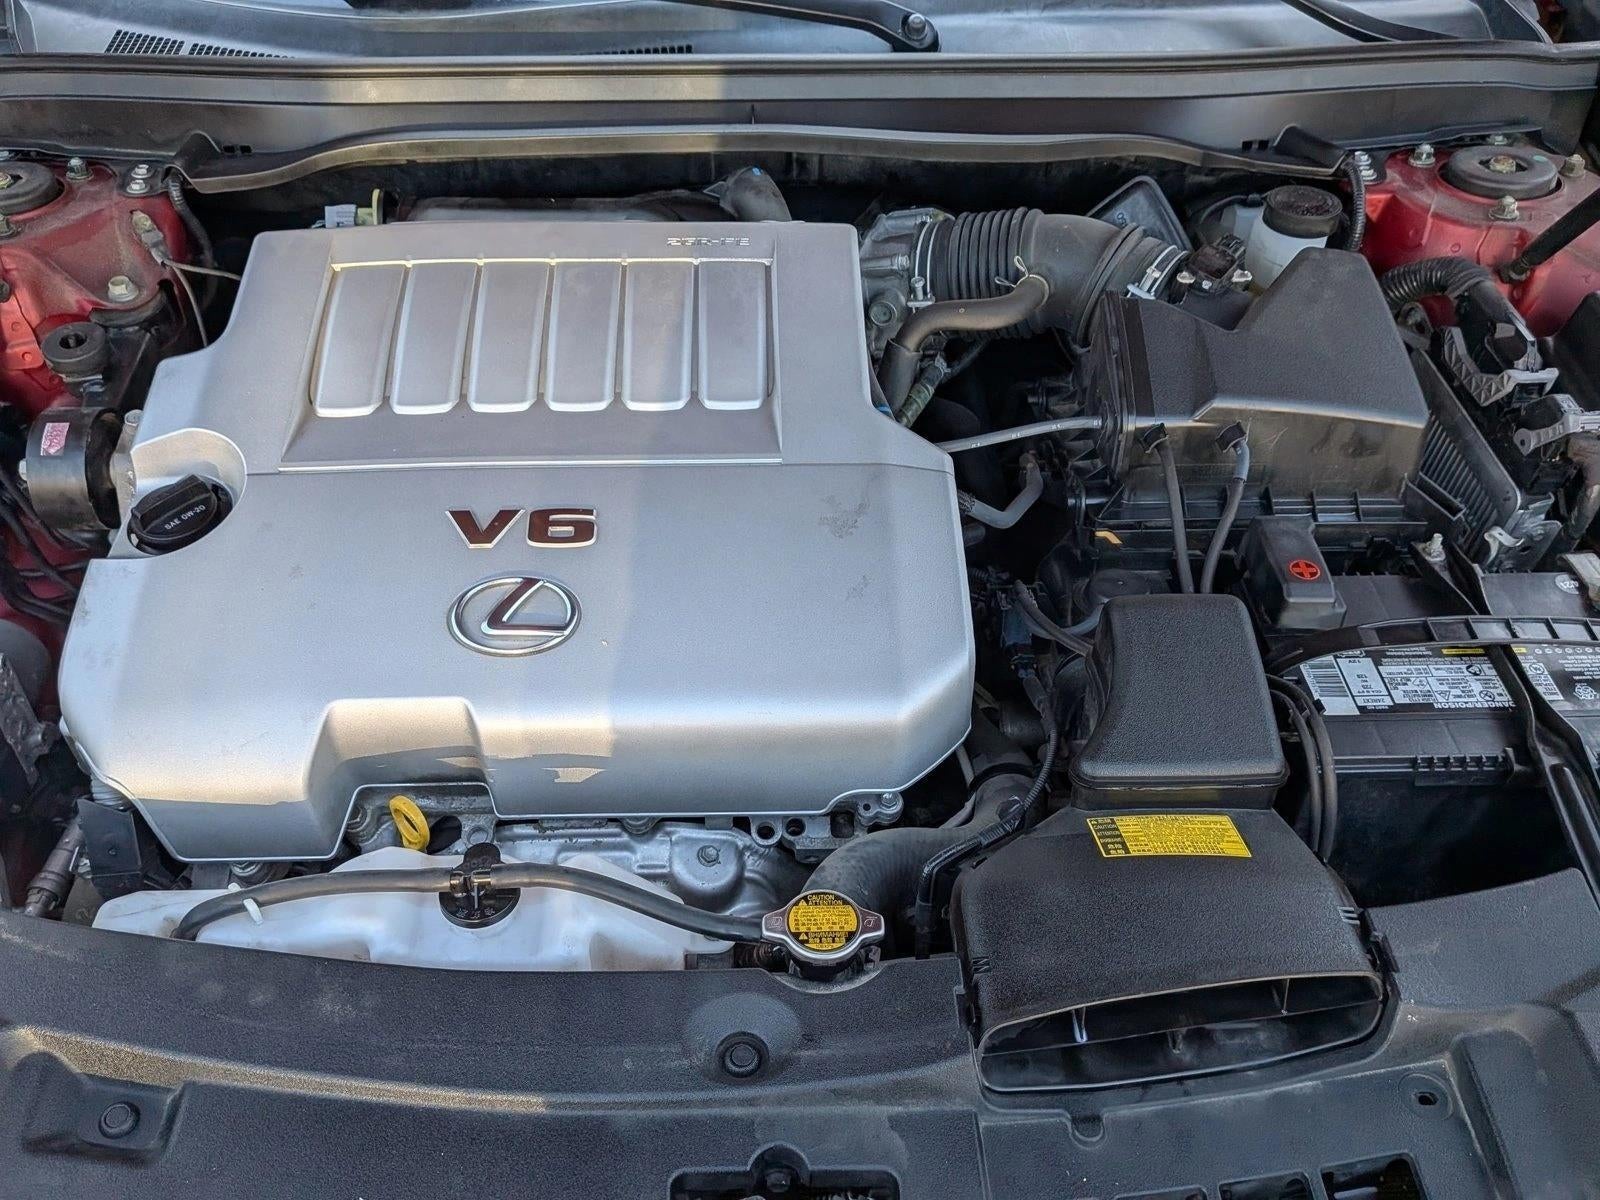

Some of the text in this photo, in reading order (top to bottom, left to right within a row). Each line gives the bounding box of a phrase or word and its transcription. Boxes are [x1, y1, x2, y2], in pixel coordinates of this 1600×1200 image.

[164, 504, 206, 530] SAE 0W-20
[445, 508, 599, 550] V6
